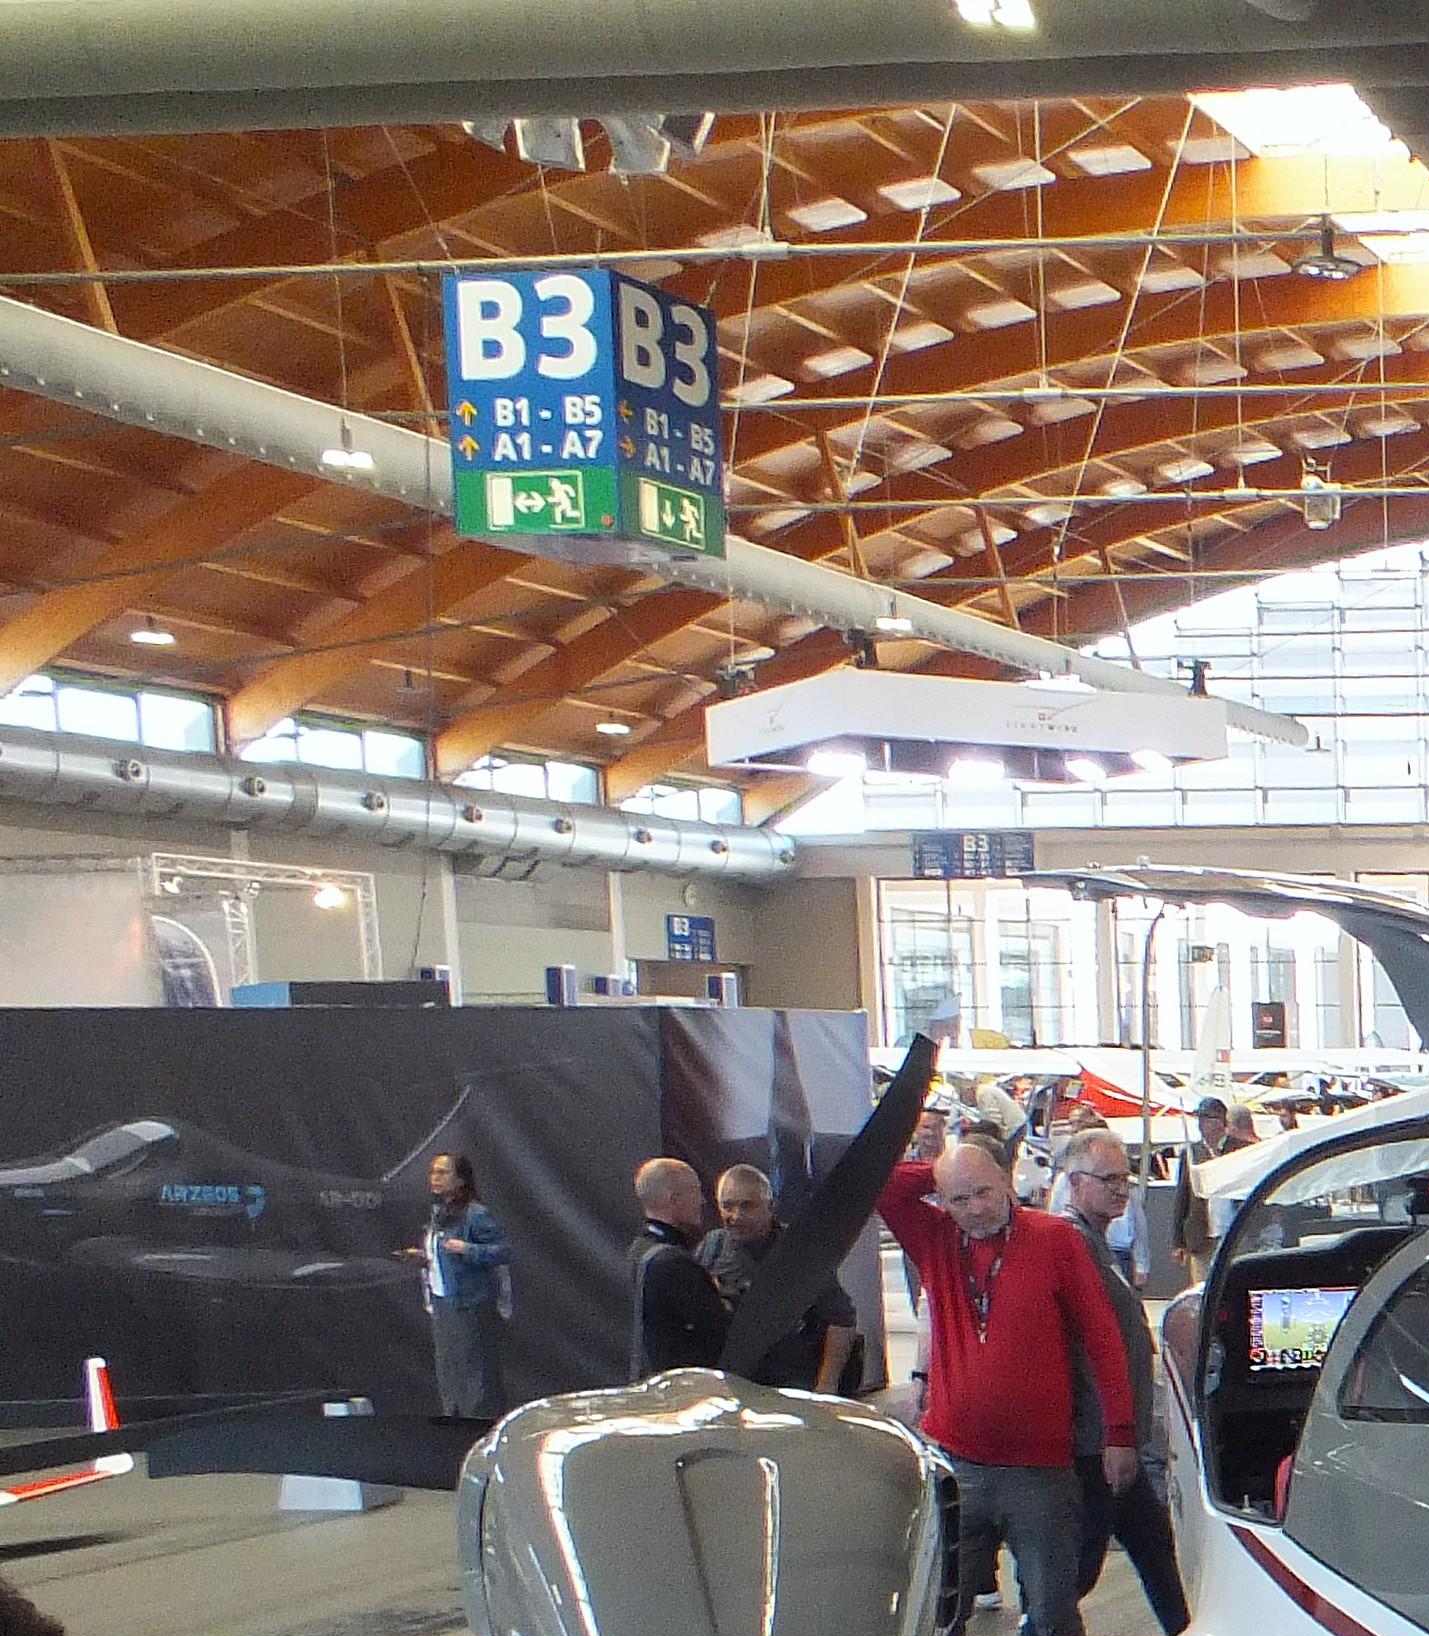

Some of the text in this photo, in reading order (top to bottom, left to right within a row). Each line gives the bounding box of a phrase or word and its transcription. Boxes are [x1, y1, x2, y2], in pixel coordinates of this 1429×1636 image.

[458, 274, 598, 381] B3
[619, 282, 712, 407] B3
[494, 397, 531, 428] B1
[563, 395, 603, 426] B5
[644, 409, 669, 438] B1
[689, 424, 715, 455] B5
[494, 433, 531, 461] A1
[562, 431, 603, 459] A7
[644, 443, 670, 473] A1
[688, 460, 715, 486] A7
[963, 834, 990, 852] B3
